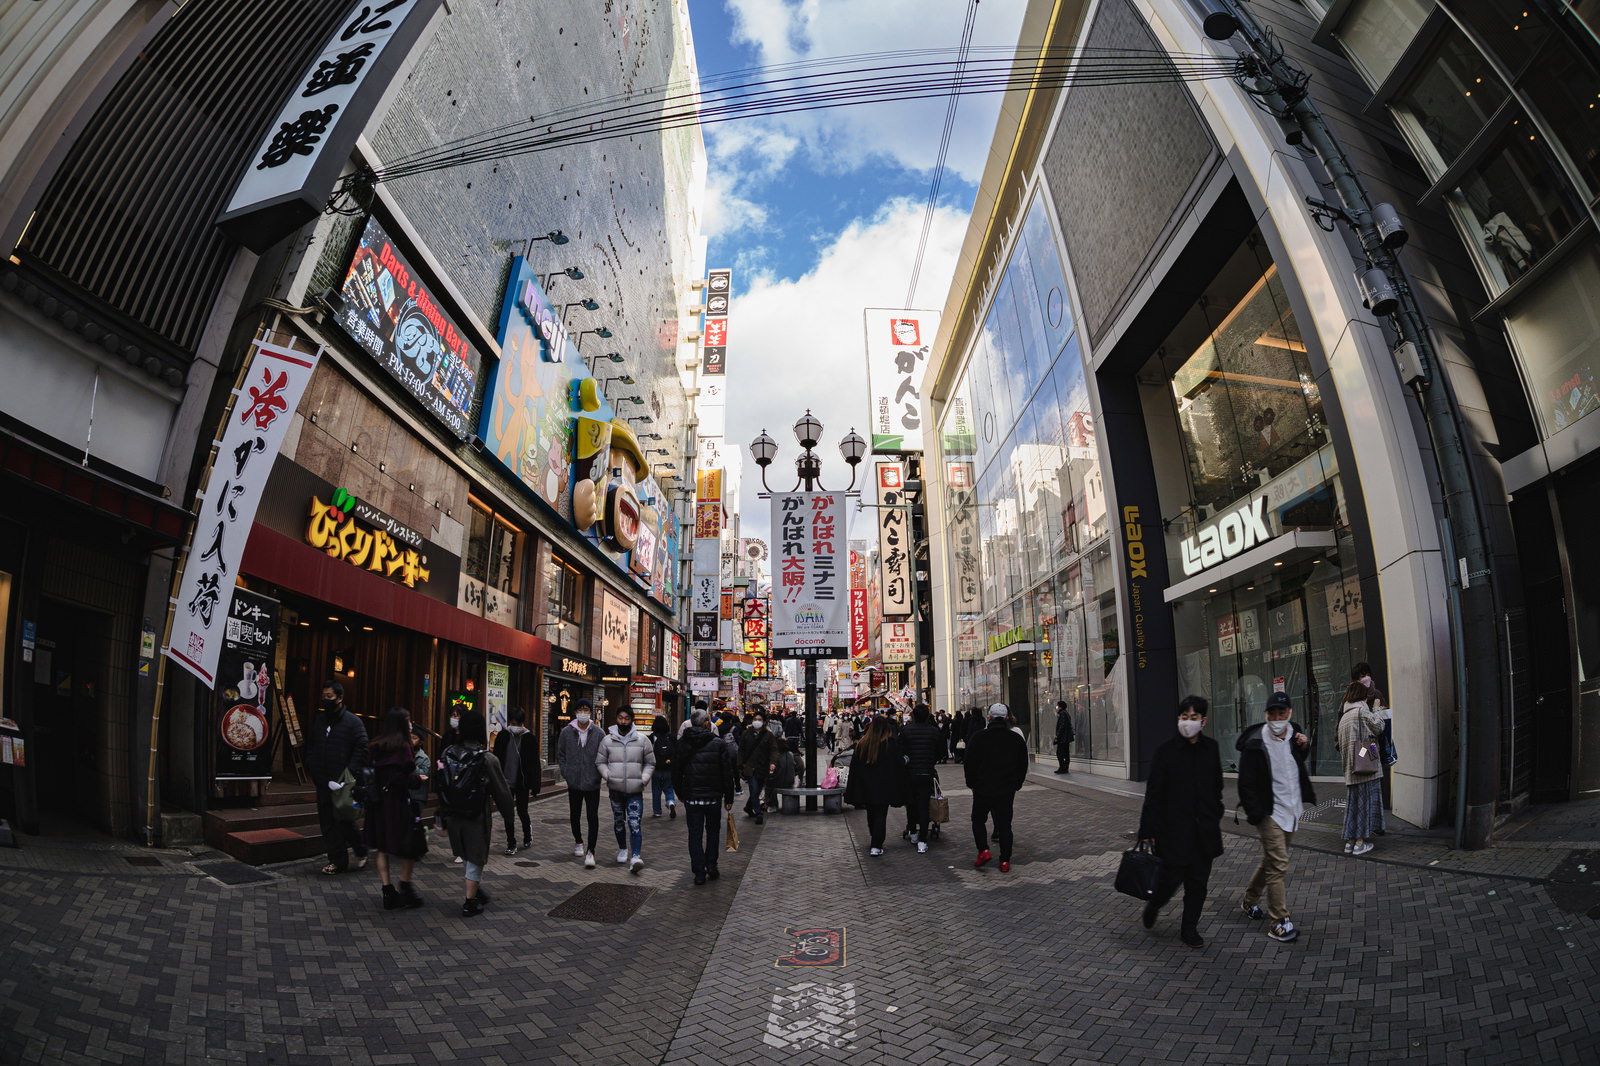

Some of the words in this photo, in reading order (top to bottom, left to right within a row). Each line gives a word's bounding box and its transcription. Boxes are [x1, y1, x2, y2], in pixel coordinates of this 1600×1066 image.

[379, 242, 410, 290] Darts
[407, 281, 417, 300] &
[416, 287, 446, 336] Dining
[445, 324, 463, 353] Bar
[524, 279, 568, 363] meiji
[346, 309, 385, 356] 営業時間
[388, 352, 404, 377] PM
[403, 368, 426, 397] 17:00
[432, 398, 447, 416] AM
[445, 410, 461, 431] 5:00
[878, 396, 891, 434] 道頓堀店
[894, 345, 930, 430] がんこ
[188, 366, 290, 630] 活かに入荷
[356, 503, 423, 546] ハンバーグレストラン
[304, 495, 431, 588] びっくりドンキー
[781, 496, 806, 604] がんばれ大阪!!
[811, 495, 836, 601] がんばれミナミ
[882, 490, 906, 606] がんこ寿司
[226, 616, 273, 647] 満喫セット
[233, 598, 271, 622] ドンキー
[853, 590, 866, 650] ツルハドラッグ
[1131, 582, 1142, 612] Japan
[1132, 613, 1145, 649] Quality
[1136, 650, 1147, 669] Life
